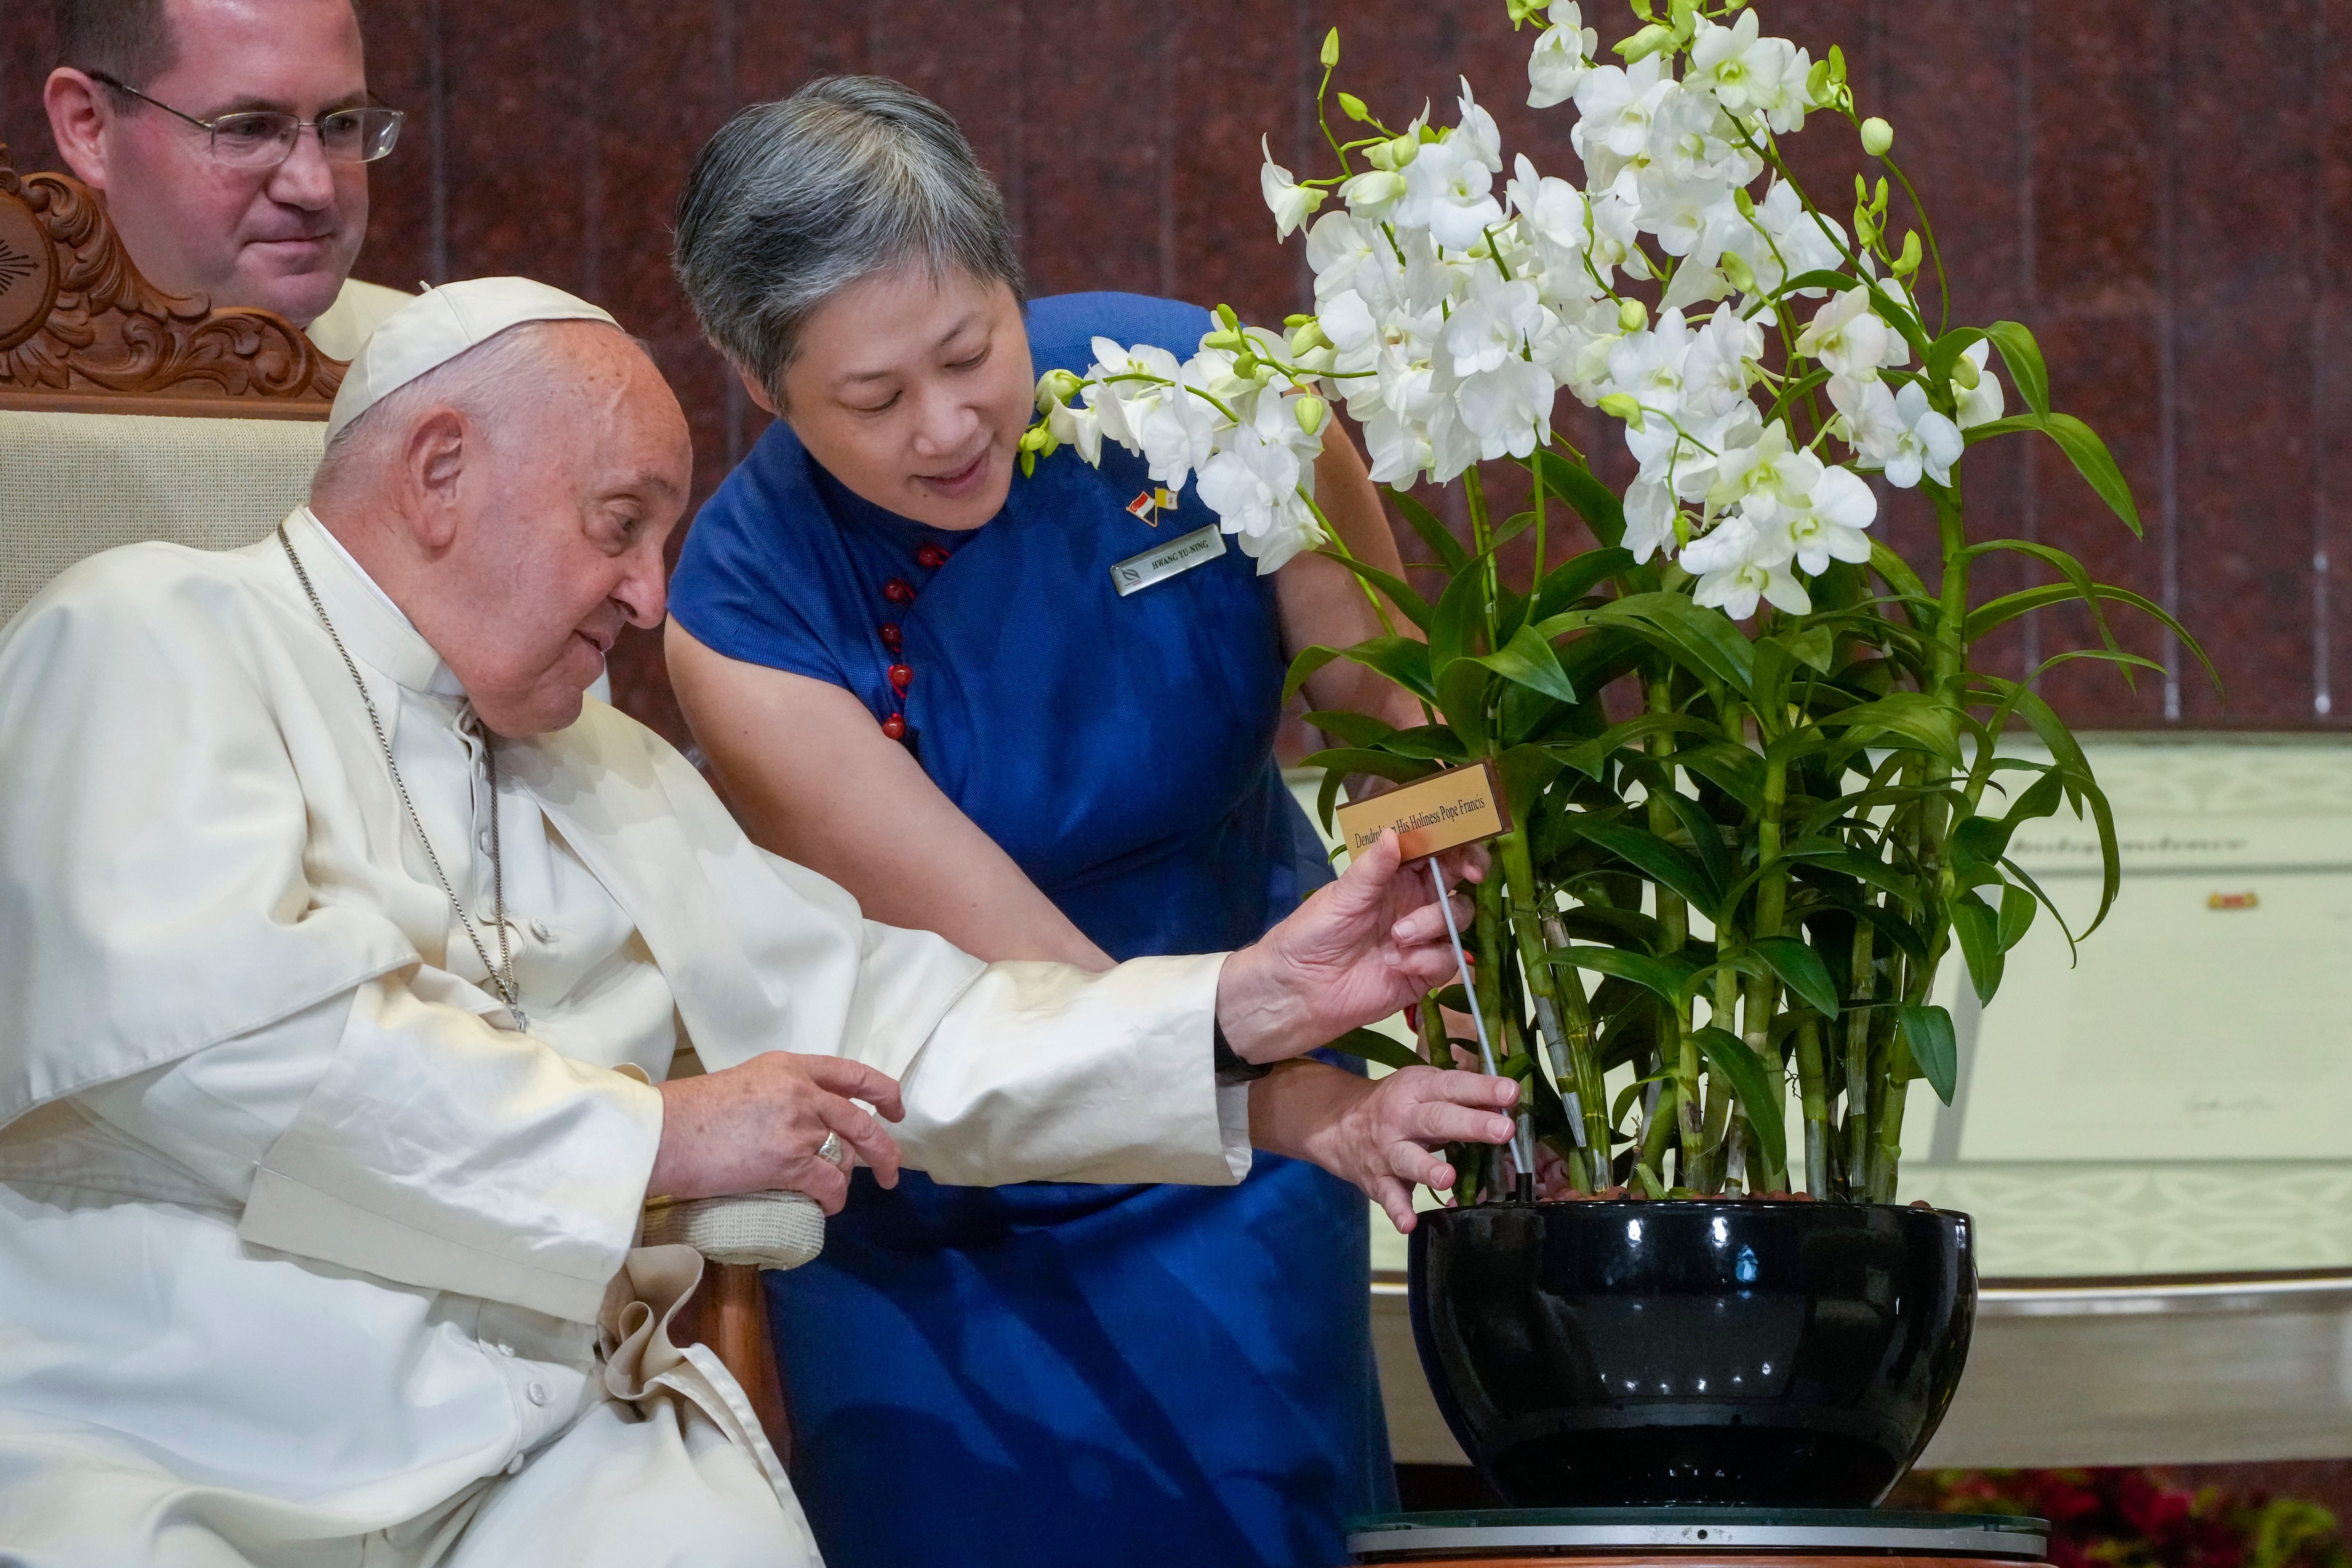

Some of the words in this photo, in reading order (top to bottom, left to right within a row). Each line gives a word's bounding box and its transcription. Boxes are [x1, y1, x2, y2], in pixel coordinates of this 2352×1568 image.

[1152, 553, 1178, 570] HWANG
[1178, 540, 1209, 558] YU-NING
[1354, 825, 1397, 848] Dendro
[1396, 817, 1410, 834] His
[1409, 811, 1441, 831] Holiness
[1439, 806, 1458, 822] Pope
[1457, 793, 1485, 815] Francis
